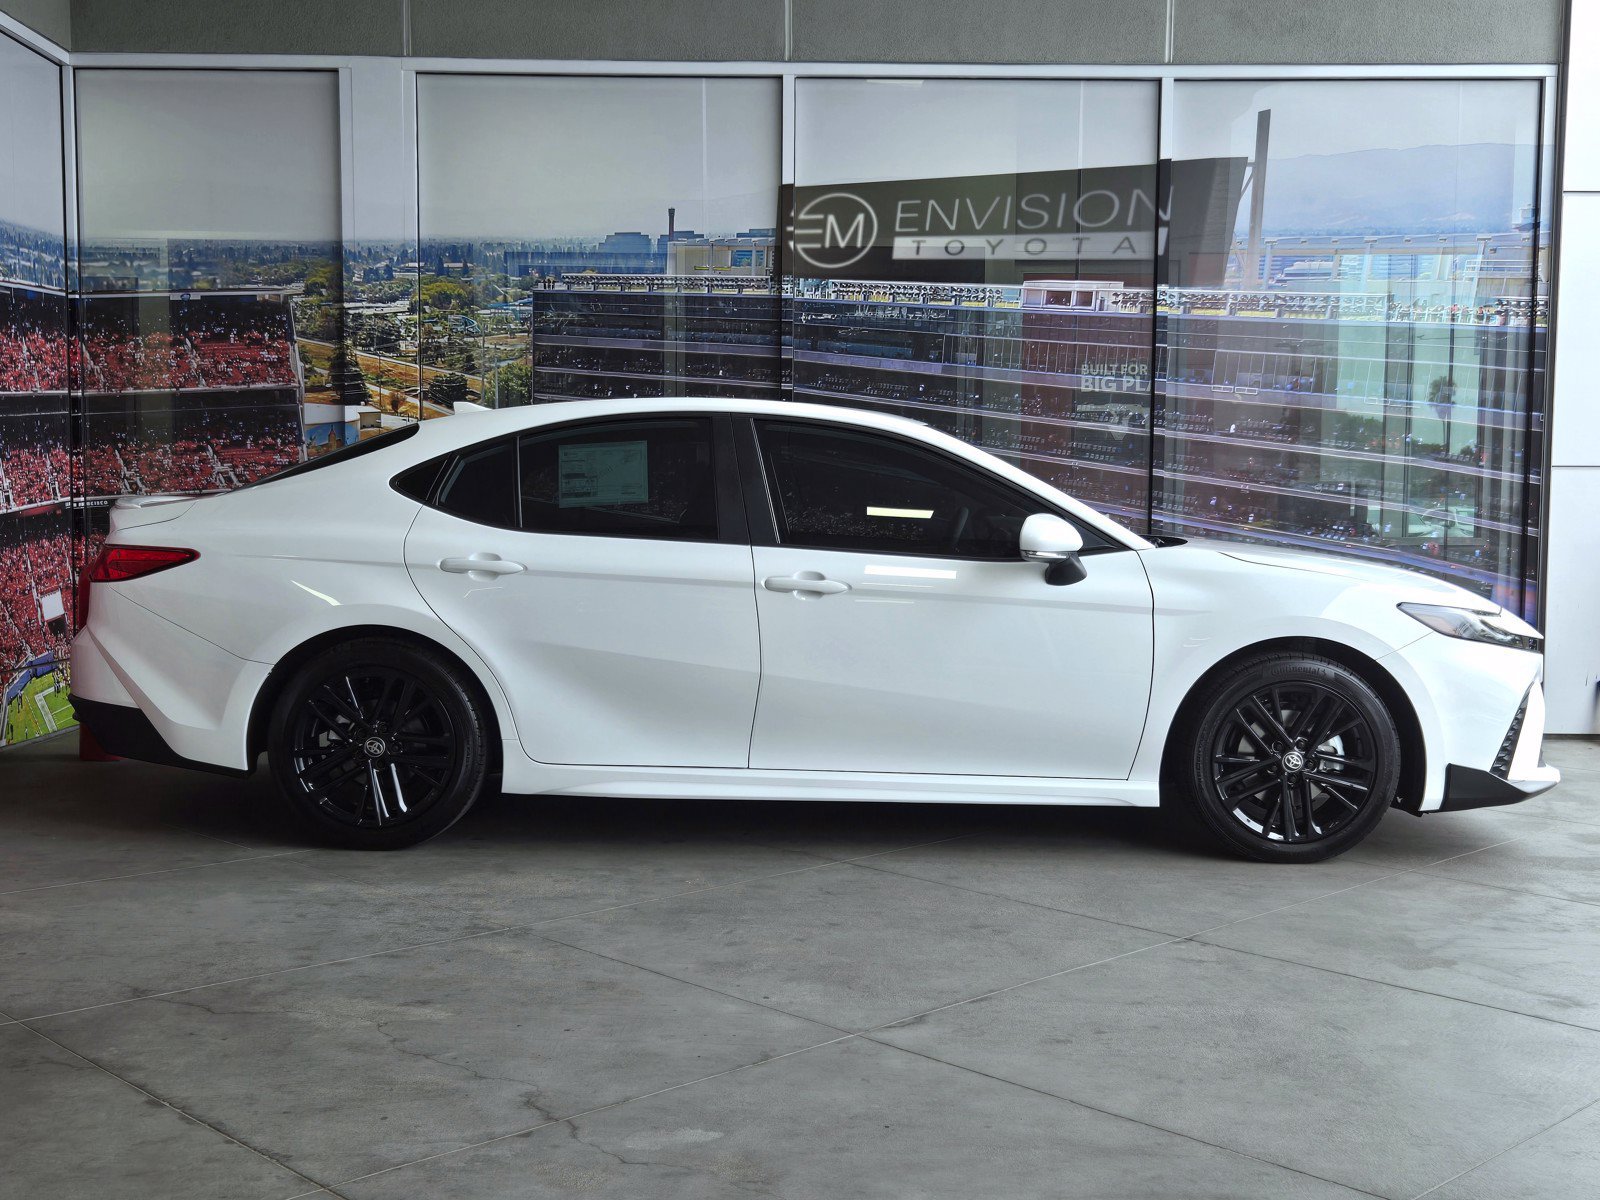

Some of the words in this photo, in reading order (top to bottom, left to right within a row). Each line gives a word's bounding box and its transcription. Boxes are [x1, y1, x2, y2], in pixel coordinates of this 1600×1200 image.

[895, 186, 1174, 232] ENVISION
[912, 236, 1137, 256] TOYOTA
[1081, 363, 1118, 375] BUILT
[1121, 363, 1148, 375] FOR
[1080, 375, 1117, 392] BIG
